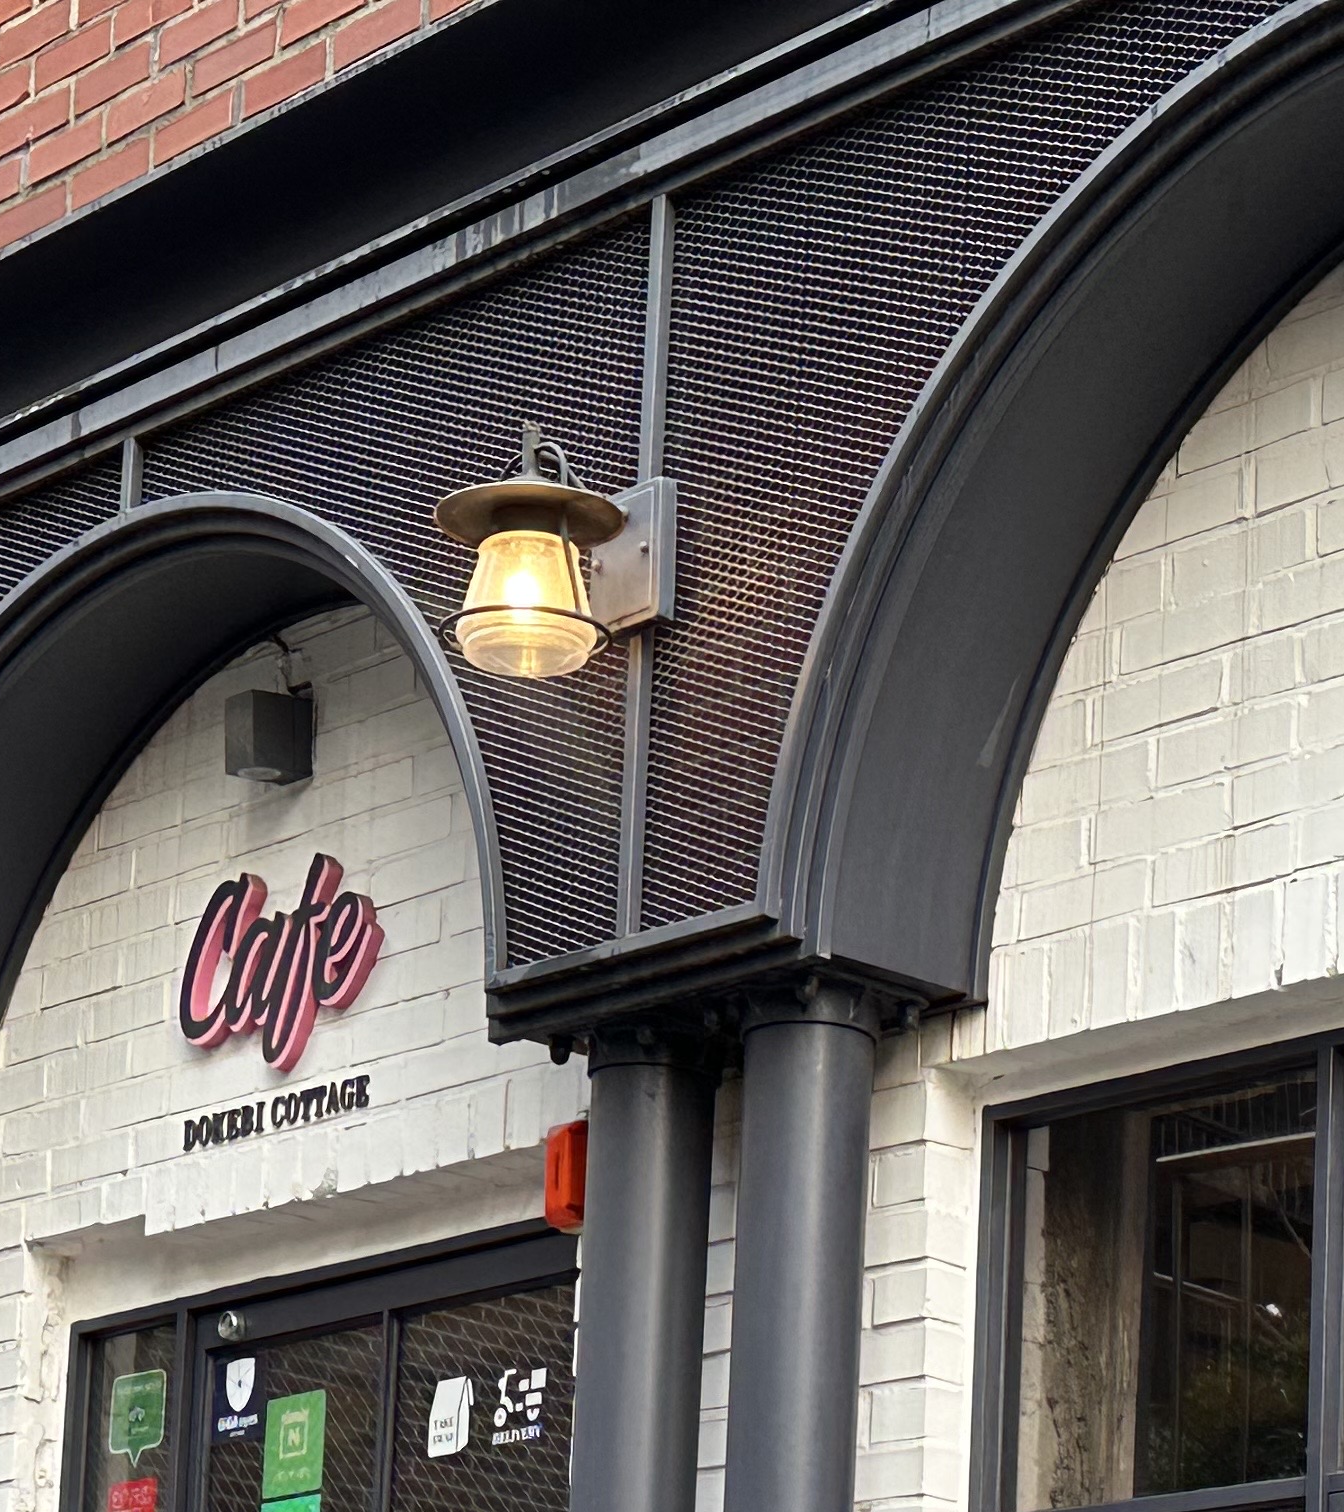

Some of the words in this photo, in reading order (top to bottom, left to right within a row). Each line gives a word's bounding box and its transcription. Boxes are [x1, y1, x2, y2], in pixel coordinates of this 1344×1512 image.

[179, 853, 386, 1073] Cafe
[183, 1101, 266, 1152] DOKEBI
[271, 1075, 370, 1128] COTTAGE
